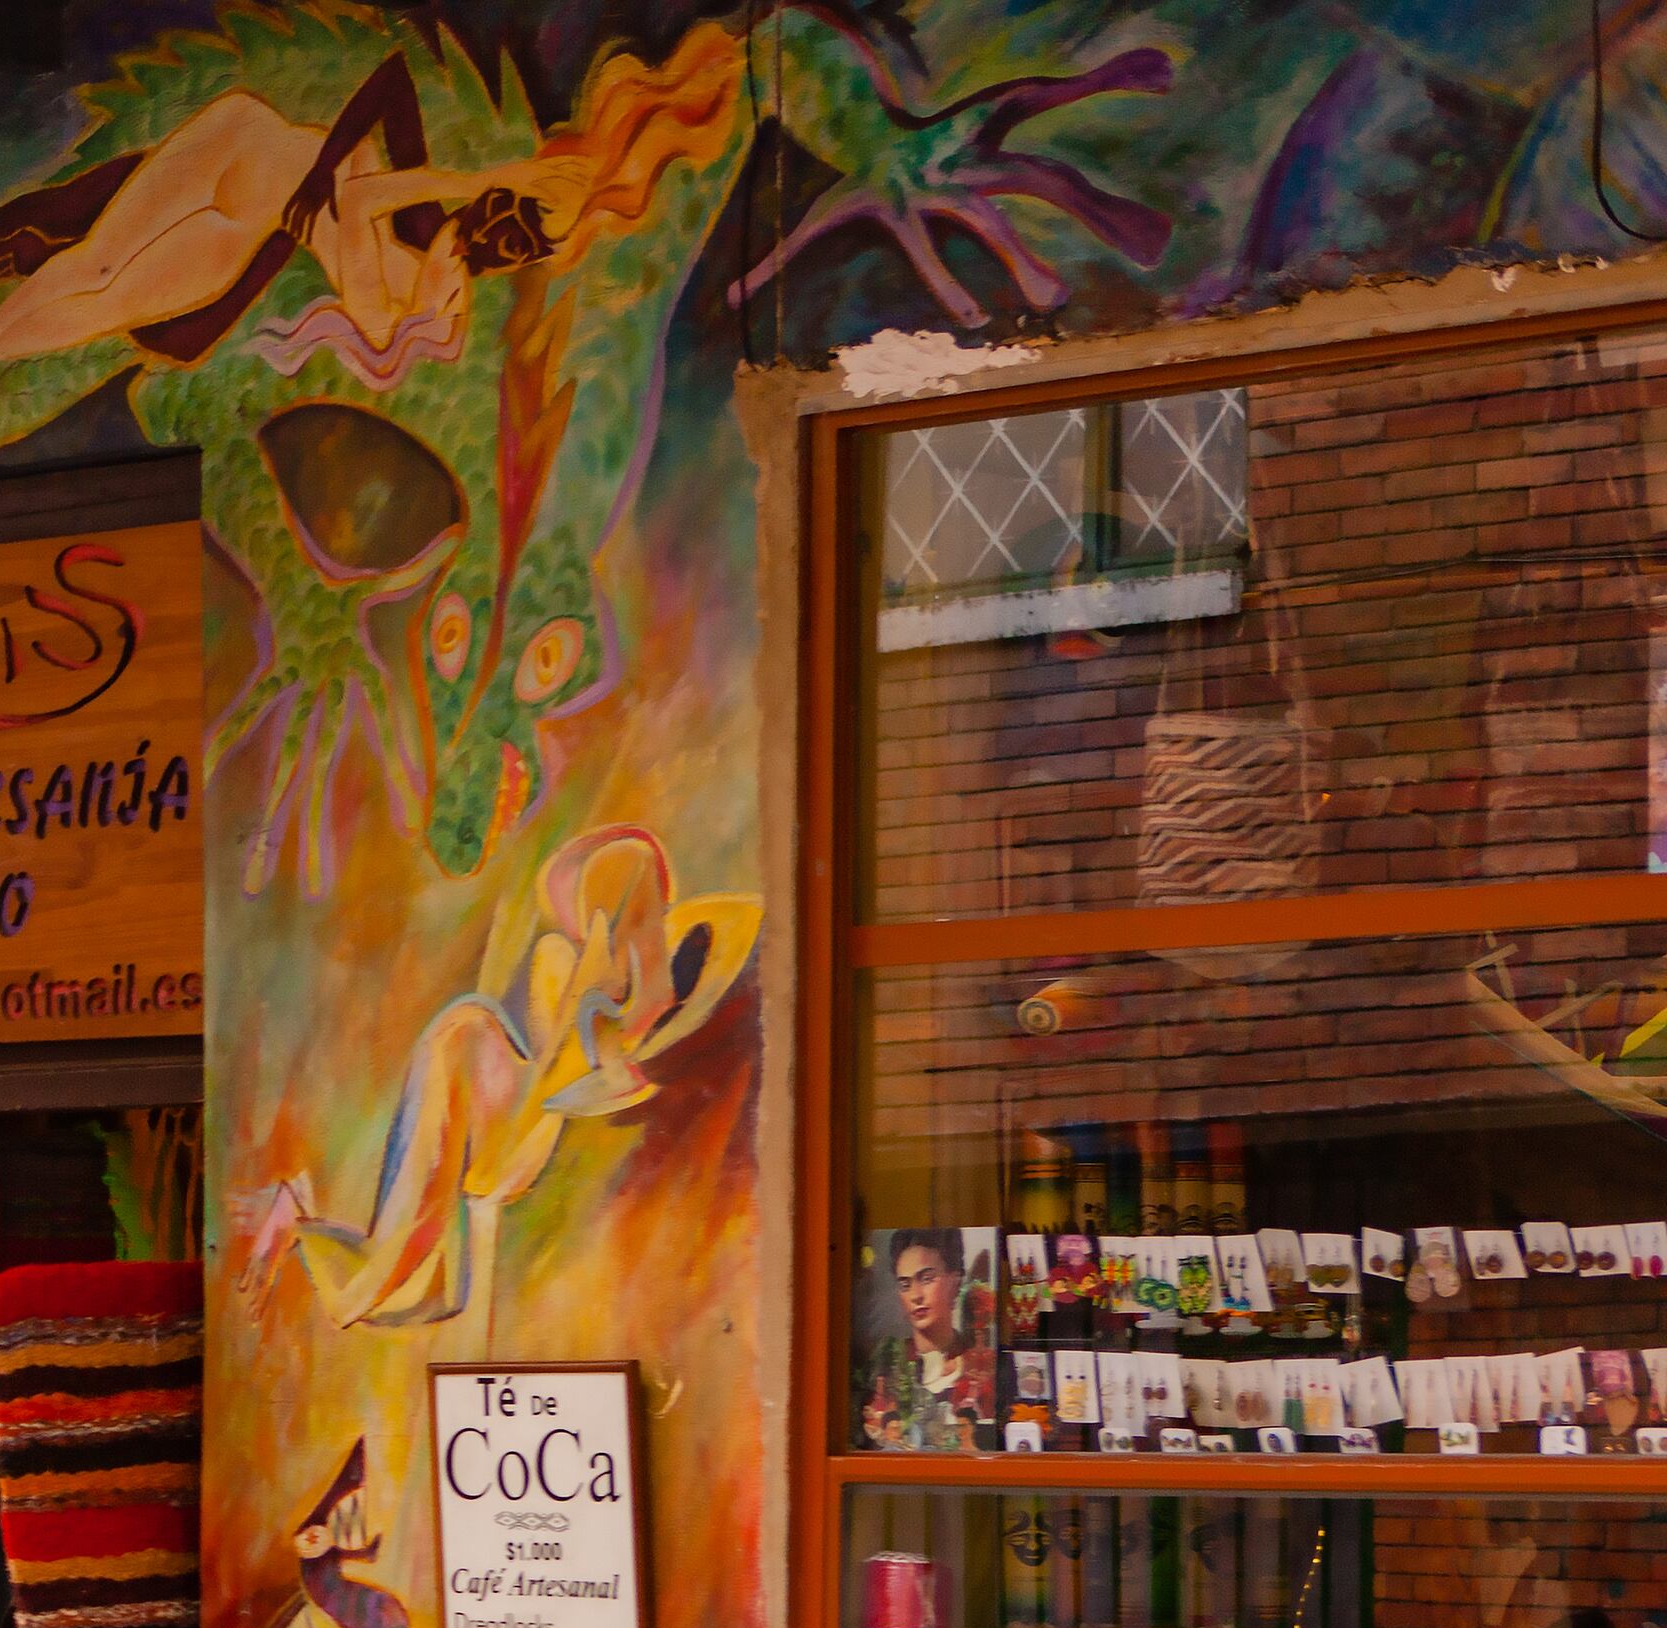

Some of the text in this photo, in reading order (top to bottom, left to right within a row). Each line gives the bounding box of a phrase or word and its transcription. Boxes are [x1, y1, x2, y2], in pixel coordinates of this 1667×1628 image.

[477, 1376, 516, 1417] Té
[446, 1427, 621, 1502] CoCa
[506, 1542, 563, 1561] $1.000
[451, 1567, 620, 1602] Café Artesanal
